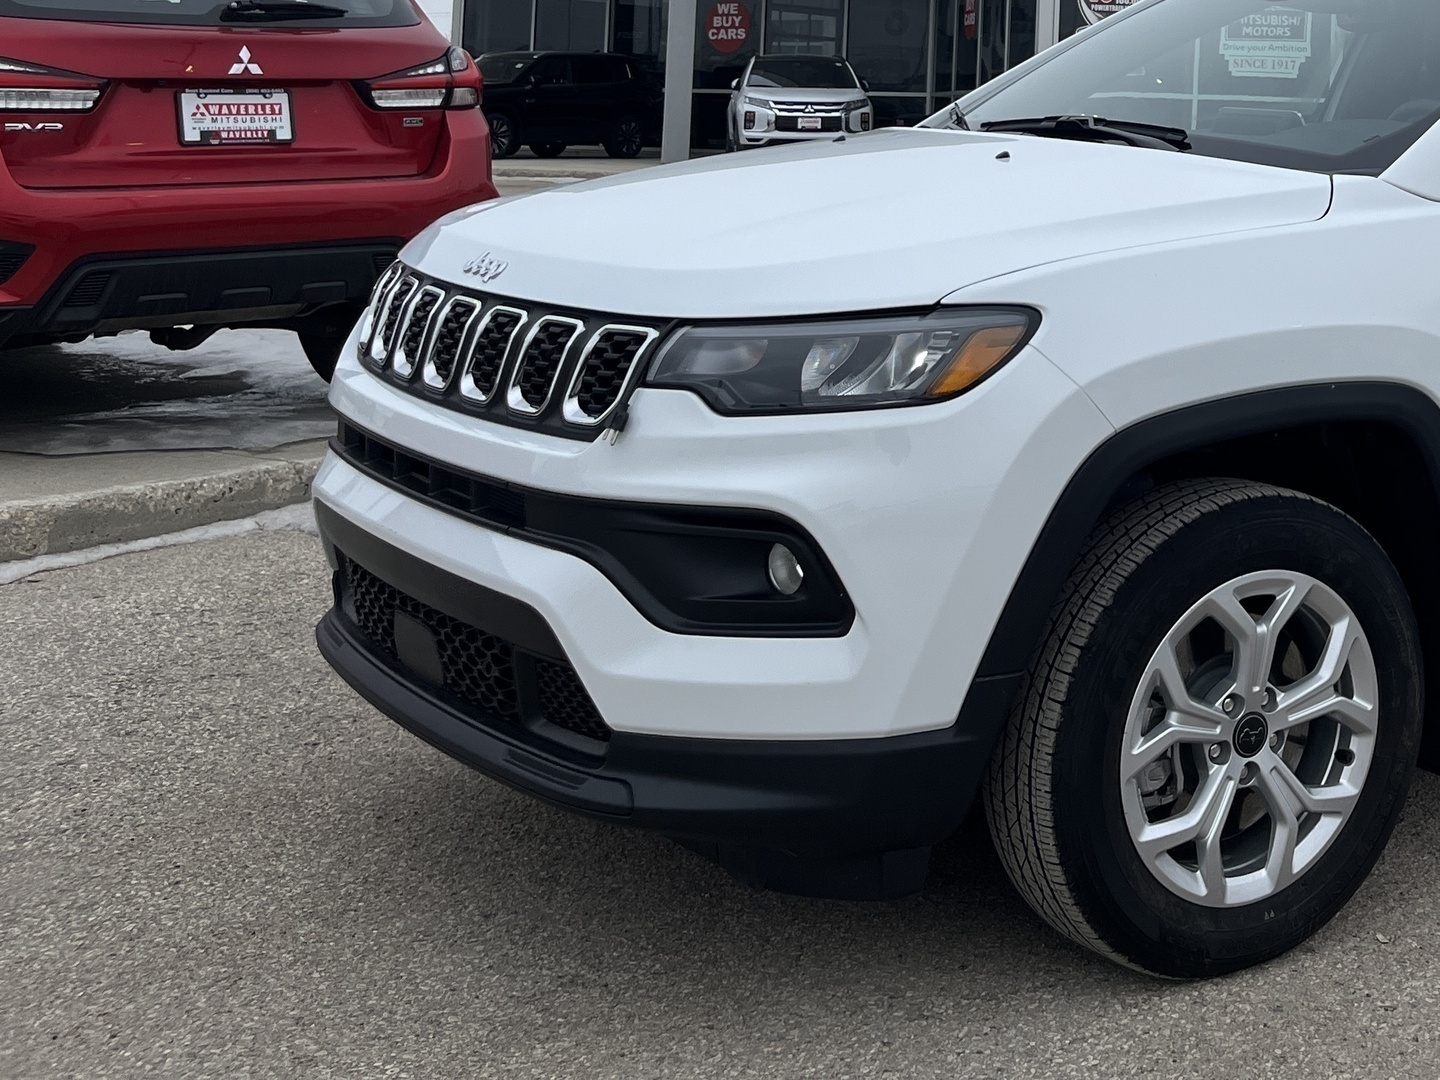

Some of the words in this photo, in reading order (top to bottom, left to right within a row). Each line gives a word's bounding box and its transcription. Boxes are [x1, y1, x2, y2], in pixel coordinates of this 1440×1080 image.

[717, 3, 739, 14] WE
[713, 15, 742, 27] BUY
[708, 28, 746, 40] CARS
[1242, 26, 1291, 36] MOTORS
[1223, 43, 1246, 51] Drive
[1247, 45, 1267, 53] your
[1268, 44, 1308, 53] Ambition
[1233, 58, 1268, 70] SINCE
[1271, 59, 1296, 71] 1917
[208, 104, 281, 115] WAVERLEY
[211, 116, 283, 124] MITSUBISHI
[221, 130, 269, 138] WAVERLEY
[463, 249, 509, 284] Jeep
